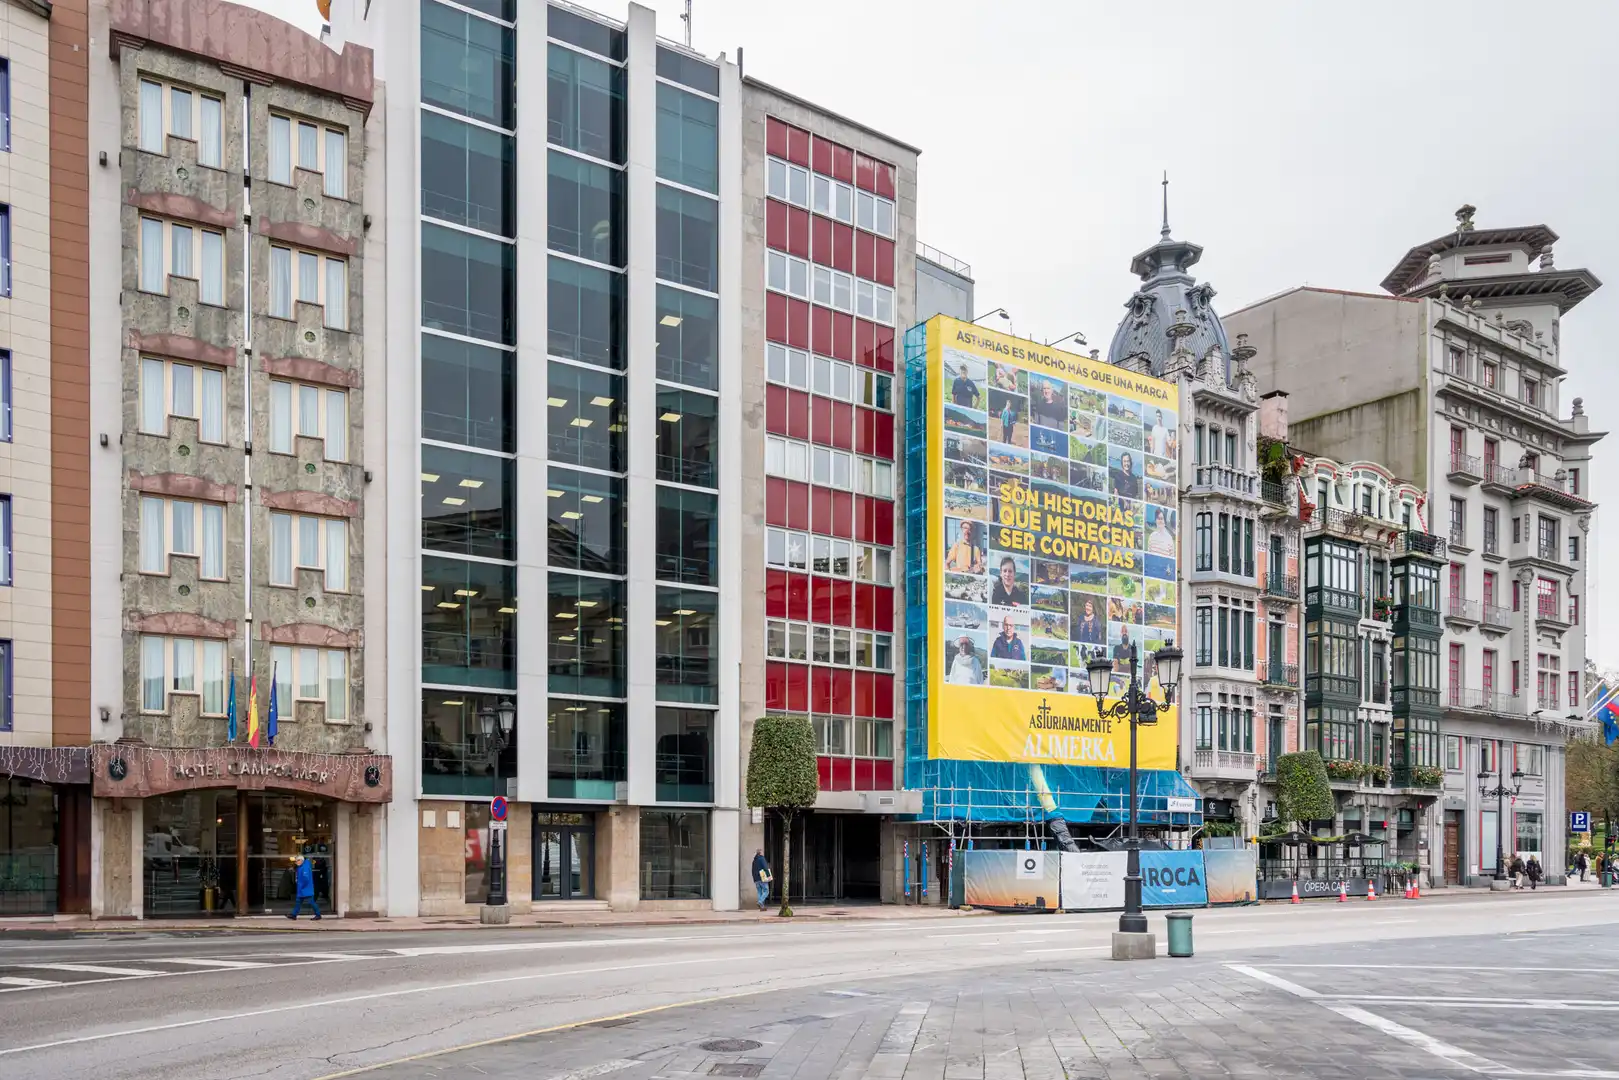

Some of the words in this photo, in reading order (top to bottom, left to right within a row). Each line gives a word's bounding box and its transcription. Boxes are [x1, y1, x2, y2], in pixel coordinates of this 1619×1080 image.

[956, 330, 1010, 355] ASTURIAS
[1012, 346, 1026, 360] ES
[1027, 351, 1067, 371] MUCHO
[1067, 363, 1089, 378] MÁS
[1091, 370, 1112, 385] QUE
[1113, 376, 1134, 392] UNA
[1135, 382, 1169, 401] MARCA
[999, 483, 1039, 509] SON
[1043, 491, 1135, 528] HISTORIAS
[999, 504, 1042, 532] QUE
[1046, 513, 1135, 549] MERECEN
[999, 527, 1036, 552] SER
[1040, 535, 1135, 570] CONTADAS
[1029, 706, 1112, 734] ASTURIANAMENTE
[1023, 733, 1117, 762] ALIMERKA
[228, 761, 328, 783] CAMPOAMOR
[1304, 880, 1330, 892] ÓPERA
[1331, 880, 1351, 891] CAÉ
